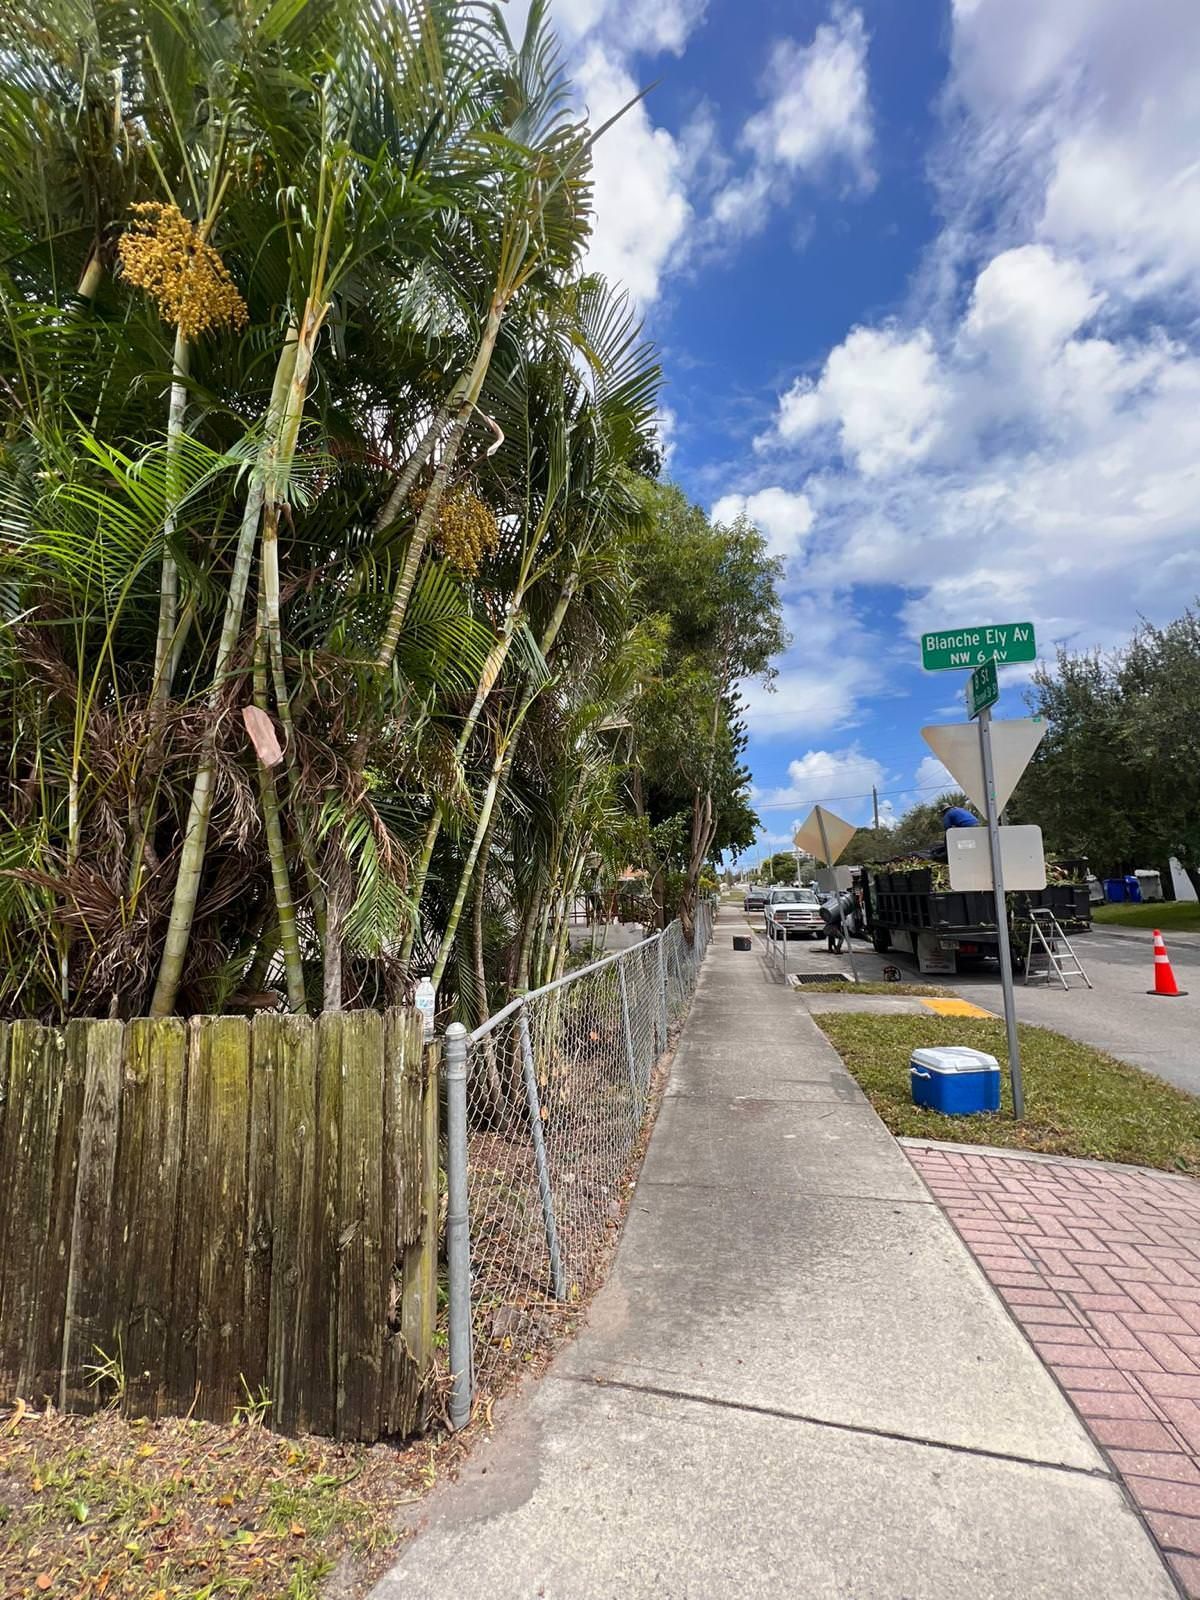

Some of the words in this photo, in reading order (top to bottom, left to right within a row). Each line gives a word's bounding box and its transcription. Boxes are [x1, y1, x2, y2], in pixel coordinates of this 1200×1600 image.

[926, 632, 980, 651] Blanche
[986, 629, 1007, 647] Ely
[1013, 627, 1029, 642] Av
[950, 651, 970, 665] NW
[976, 650, 986, 662] 6
[993, 649, 1008, 661] Av
